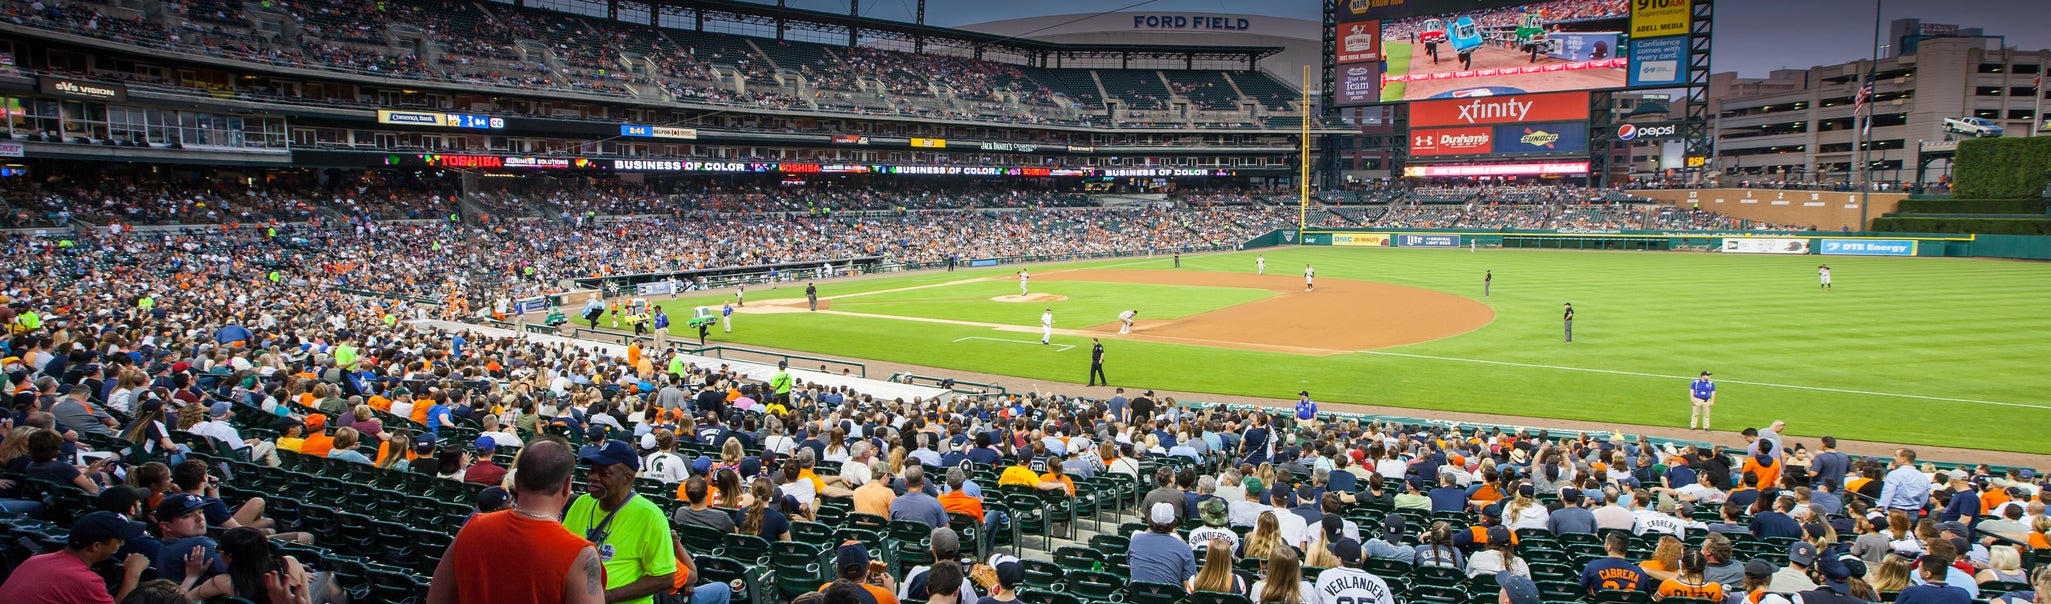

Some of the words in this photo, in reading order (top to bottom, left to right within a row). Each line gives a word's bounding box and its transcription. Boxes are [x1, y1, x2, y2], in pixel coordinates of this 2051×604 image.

[1637, 8, 1686, 17] Superstation
[1133, 15, 1187, 29] FORD
[1192, 16, 1250, 31] FIELD
[1636, 24, 1658, 32] ADELL
[1660, 22, 1684, 30] MEDIA
[1637, 40, 1681, 48] Confidence
[1344, 81, 1369, 90] Team
[79, 86, 115, 96] VISION
[1458, 98, 1533, 123] xfinity
[491, 119, 502, 127] CC
[1638, 124, 1675, 137] pepsi
[1440, 133, 1489, 145] Dunham's
[1522, 134, 1557, 142] SUNOCO
[981, 141, 993, 150] JACK
[440, 155, 501, 167] TOSHIBA
[614, 160, 682, 171] BUSINESS
[685, 161, 701, 171] OF
[704, 162, 745, 172] COLOR
[781, 163, 820, 173] TOSHIBA
[896, 166, 946, 174] BUSINESS
[949, 166, 962, 175] OF
[963, 167, 996, 175] COLOR
[1105, 169, 1156, 177] BUSINESS
[1407, 235, 1422, 245] Lite
[1867, 243, 1906, 253] Energy
[705, 435, 715, 446] 7
[1647, 520, 1678, 530] CABRERA
[1190, 531, 1236, 546] GRANDERSON
[1420, 548, 1453, 561] VERANDE
[1598, 568, 1640, 583] CABRERA
[1324, 576, 1387, 601] VERLANDER
